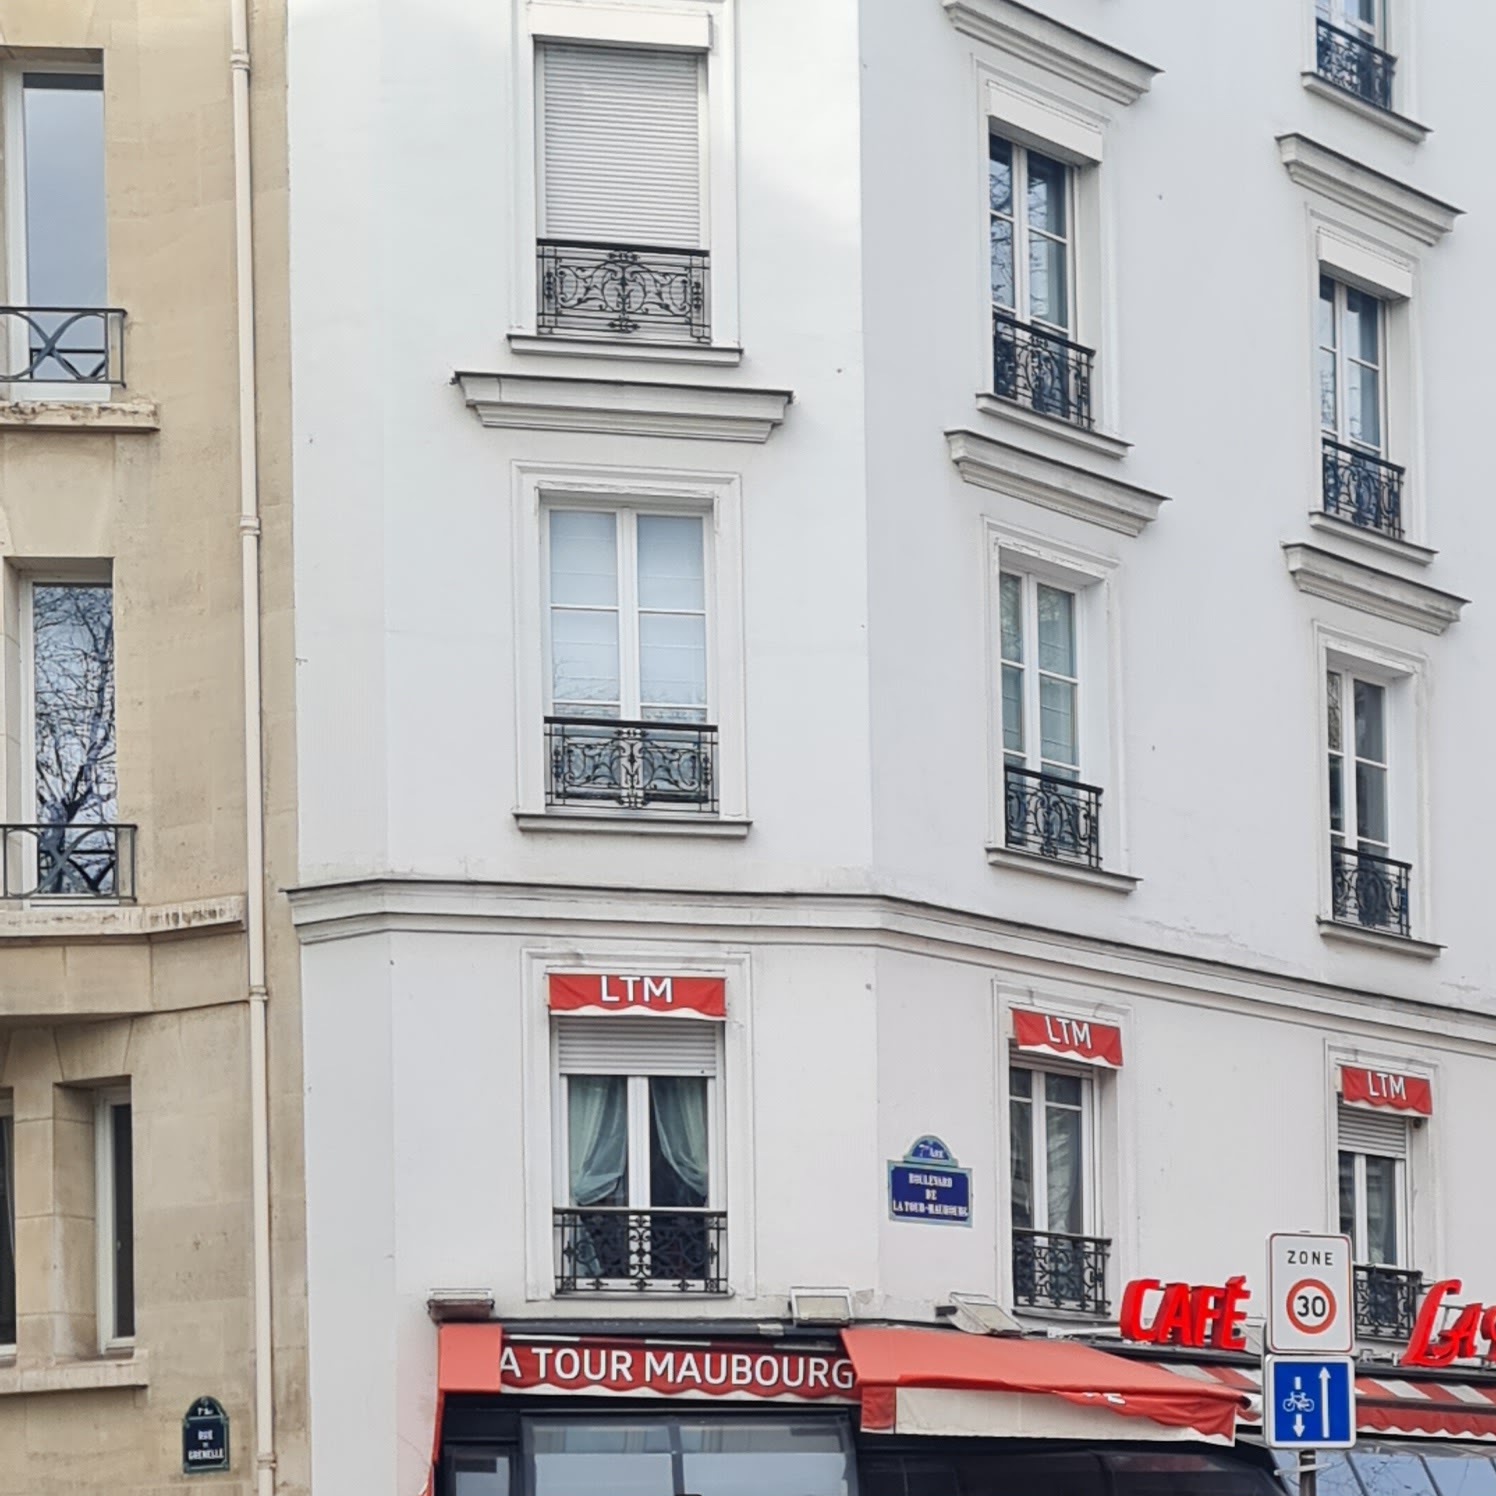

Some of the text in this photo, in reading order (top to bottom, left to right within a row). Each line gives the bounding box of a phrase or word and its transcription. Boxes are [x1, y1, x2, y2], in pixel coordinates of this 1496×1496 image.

[600, 975, 673, 1004] LTM
[1045, 1016, 1093, 1049] LTM
[1367, 1071, 1406, 1100] LTM
[908, 1173, 952, 1188] BOULEVARD
[893, 1199, 904, 1212] LA
[1287, 1250, 1334, 1266] ZONE
[1120, 1275, 1251, 1350] CAFÉ
[1297, 1295, 1326, 1318] 30
[531, 1347, 633, 1382] TOUR
[645, 1351, 854, 1389] MAUBOURG
